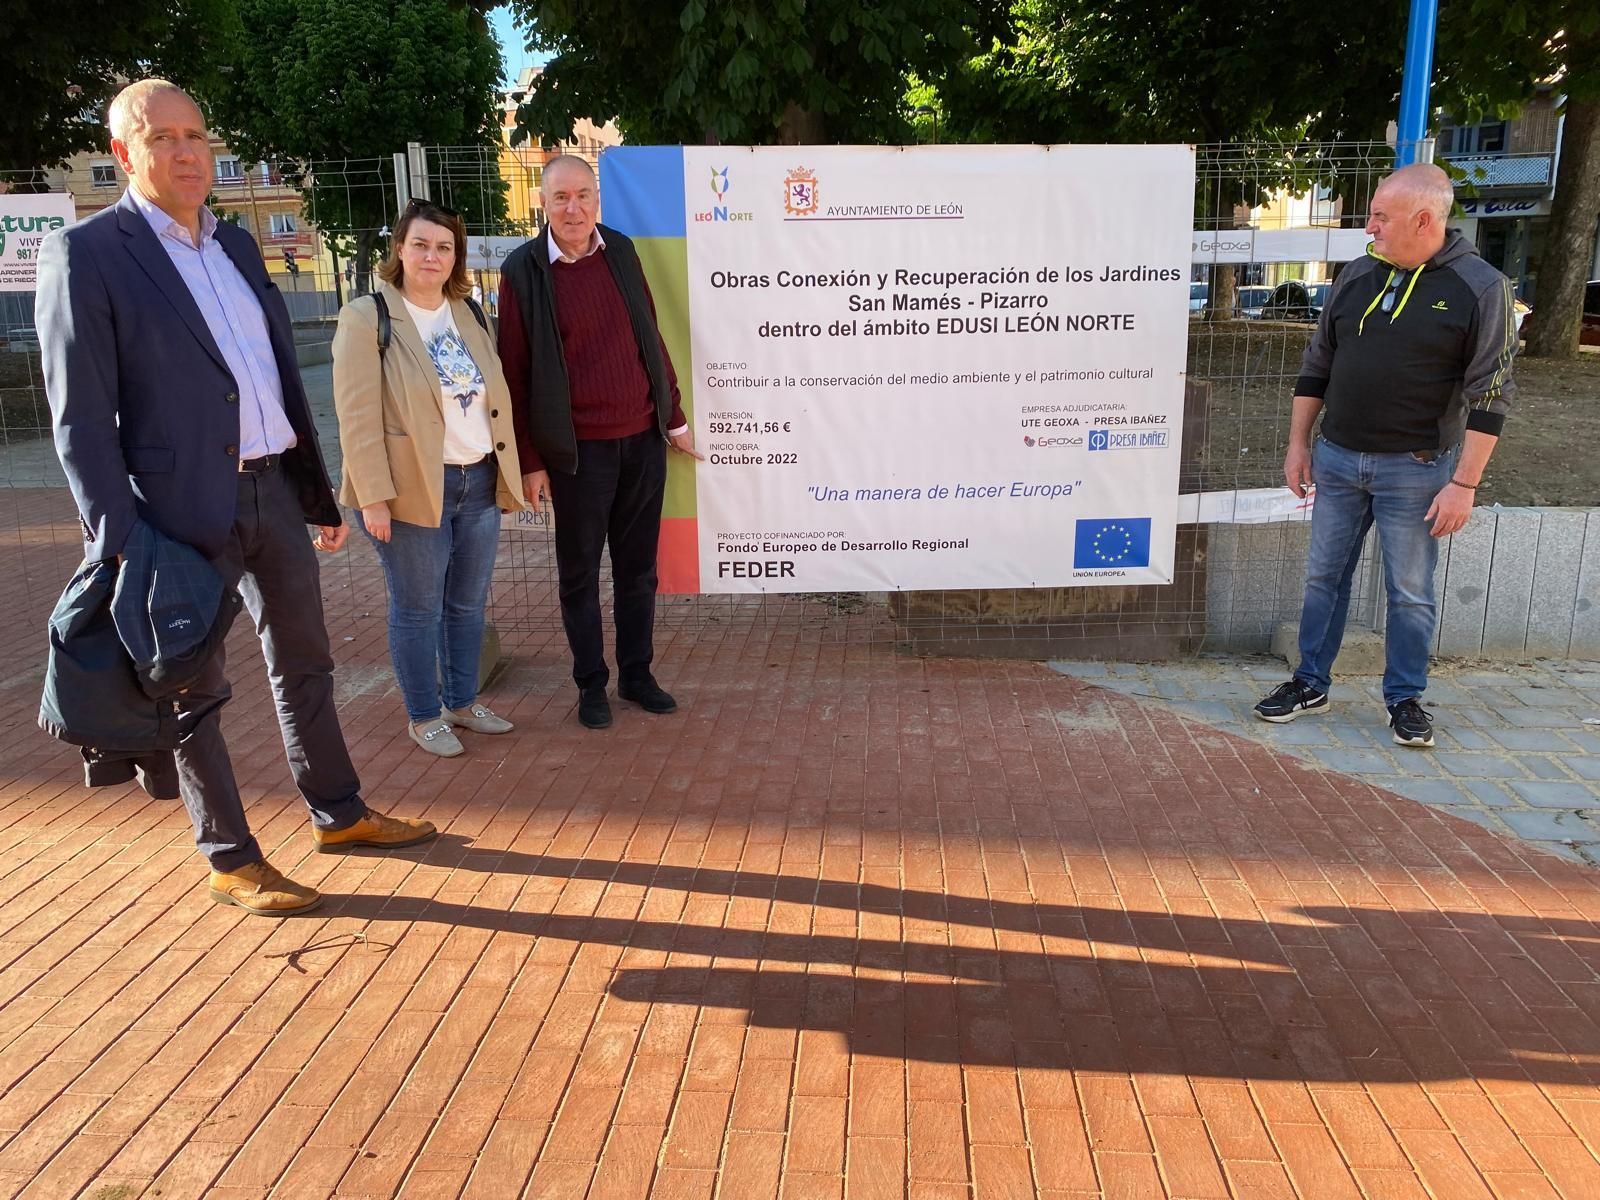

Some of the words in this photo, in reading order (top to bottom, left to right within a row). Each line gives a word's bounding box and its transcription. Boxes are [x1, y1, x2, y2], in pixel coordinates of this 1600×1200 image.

[827, 205, 913, 216] AYUNTAMIENTO
[916, 204, 931, 215] DE
[934, 202, 963, 215] LEÓN
[0, 215, 64, 232] tura
[17, 249, 31, 260] 987
[710, 271, 770, 288] Obras
[777, 269, 870, 287] Conexión
[877, 273, 889, 291] y
[895, 267, 1030, 288] Recuperación
[1036, 267, 1059, 283] de
[1066, 266, 1094, 283] los
[1100, 265, 1181, 282] Jardines
[848, 294, 885, 312] San
[892, 293, 961, 311] Mamés
[981, 292, 1048, 309] Pizarro
[758, 321, 822, 337] dentro
[828, 320, 857, 336] del
[863, 319, 930, 336] ámbito
[936, 317, 998, 334] EDUSI
[1005, 313, 1059, 332] LEÓN
[1066, 314, 1135, 332] NORTE
[707, 376, 768, 388] Contribuir
[773, 378, 781, 387] a
[785, 376, 796, 387] la
[800, 374, 883, 387] conservación
[887, 374, 906, 385] del
[910, 372, 949, 384] medio
[952, 371, 1011, 383] ambiente
[1014, 372, 1022, 384] y
[1025, 370, 1036, 382] el
[1040, 369, 1105, 384] patrimonio
[1108, 367, 1153, 380] cultural
[1021, 405, 1061, 414] EMPRESA
[709, 422, 779, 435] 592.741,56
[783, 421, 791, 433] €
[1021, 418, 1041, 427] UTE
[1044, 418, 1080, 427] GEOXA
[1094, 417, 1128, 425] PRESA
[1130, 414, 1167, 425] IBAÑEZ
[709, 443, 734, 451] INICIO
[1038, 436, 1083, 447] Geoxa
[1110, 433, 1136, 447] PRESA
[1139, 431, 1167, 446] IBAÑEZ
[710, 454, 763, 465] Octubre
[767, 453, 798, 464] 2022
[808, 486, 849, 501] "Una
[855, 487, 921, 501] manera
[927, 484, 949, 499] de
[954, 484, 1005, 499] hacer
[1010, 480, 1081, 500] Europa"
[717, 532, 762, 540] PROYECTO
[764, 531, 826, 539] COFINANCIADO
[717, 542, 759, 553] Fondo
[763, 541, 817, 554] Europeo
[821, 541, 835, 551] de
[841, 540, 908, 551] Desarrollo
[912, 538, 969, 552] Regional
[718, 560, 796, 578] FEDER
